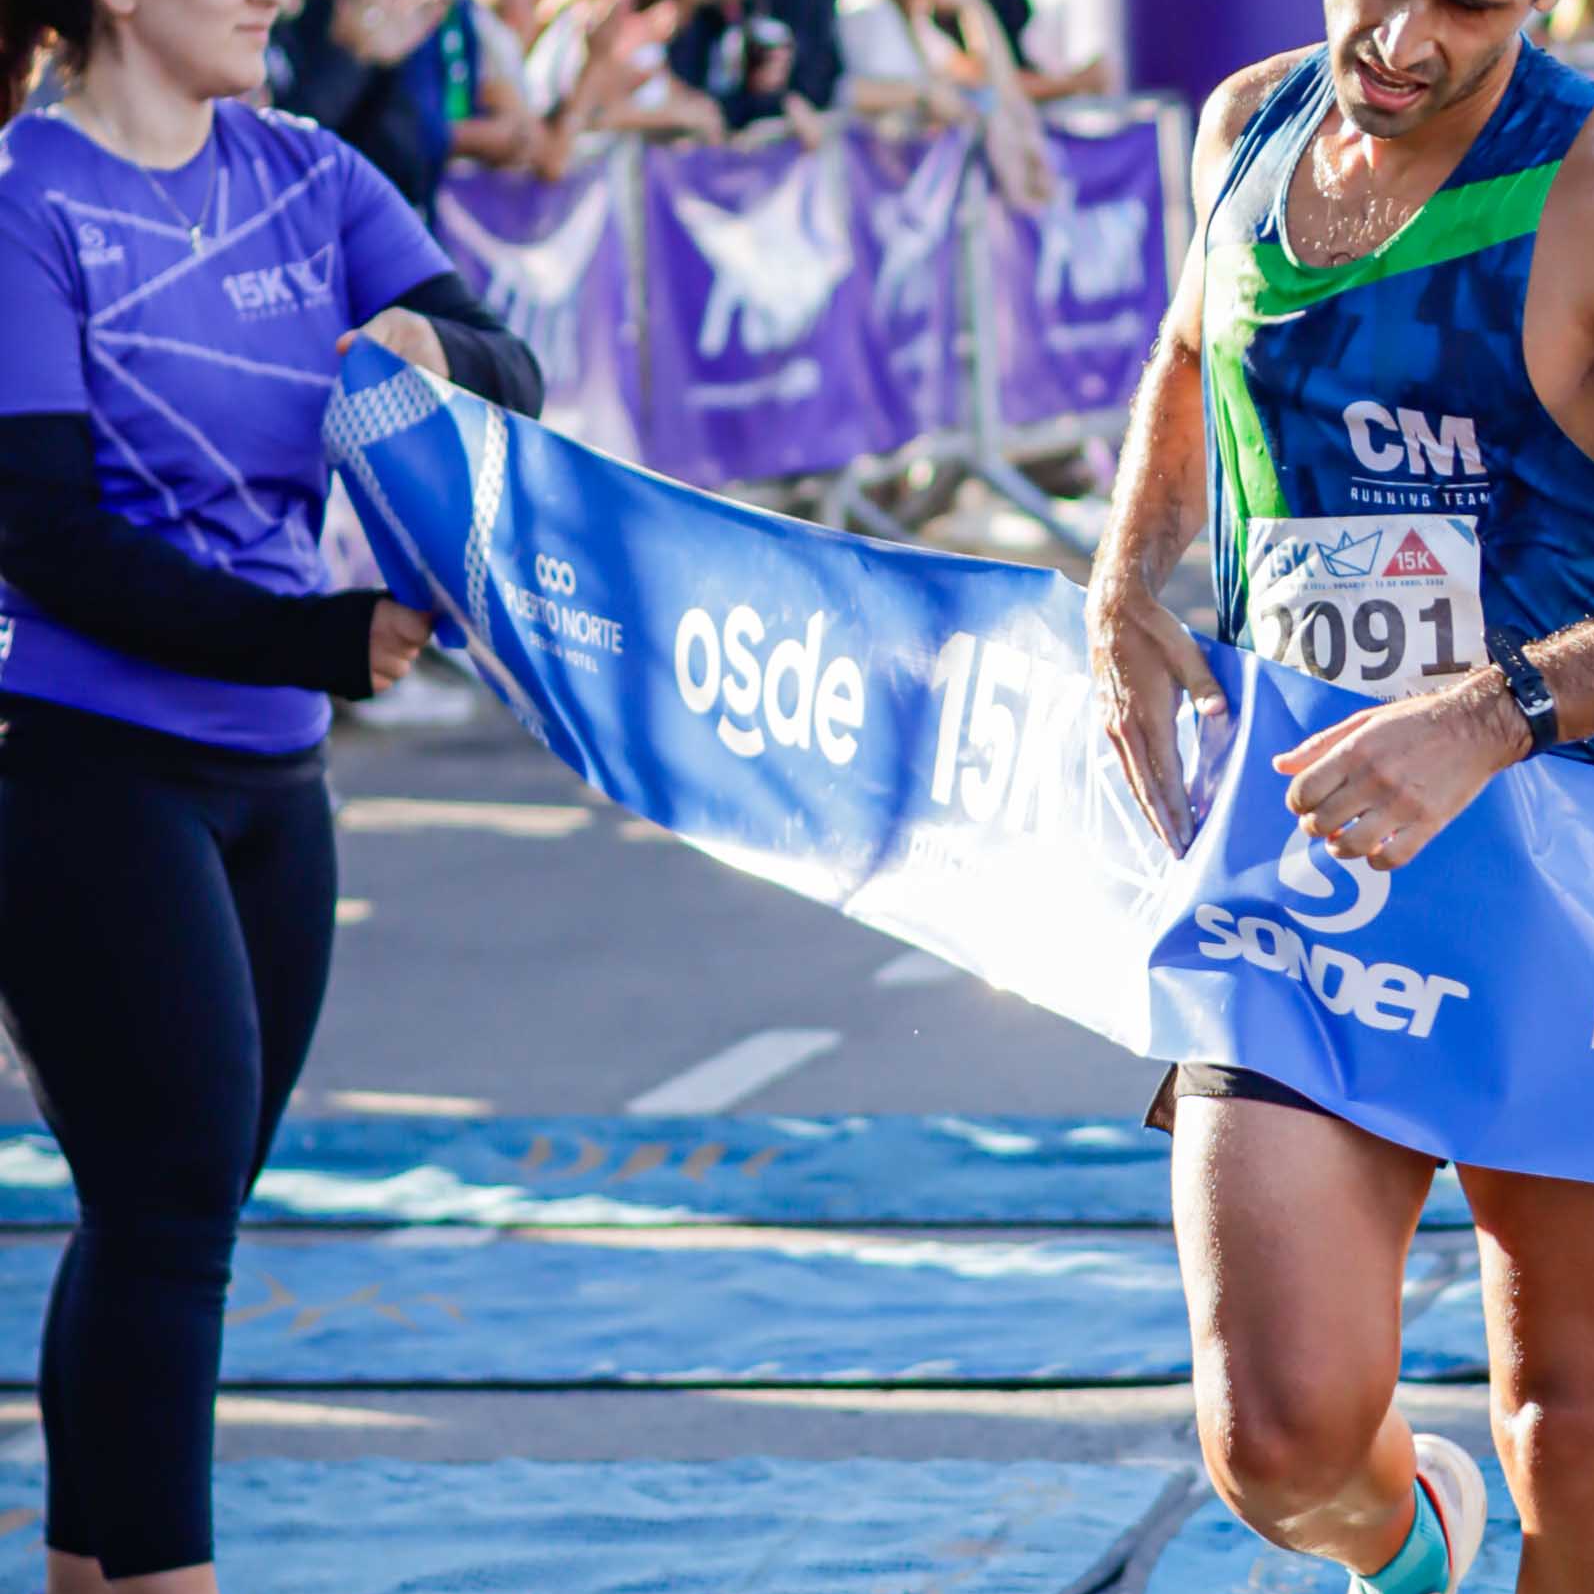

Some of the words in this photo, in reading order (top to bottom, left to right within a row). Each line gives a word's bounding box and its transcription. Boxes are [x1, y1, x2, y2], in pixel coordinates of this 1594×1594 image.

[1343, 400, 1488, 477] CM
[1350, 487, 1431, 507] RUNNING
[1395, 550, 1433, 570] 15K
[562, 606, 623, 654] NORTE
